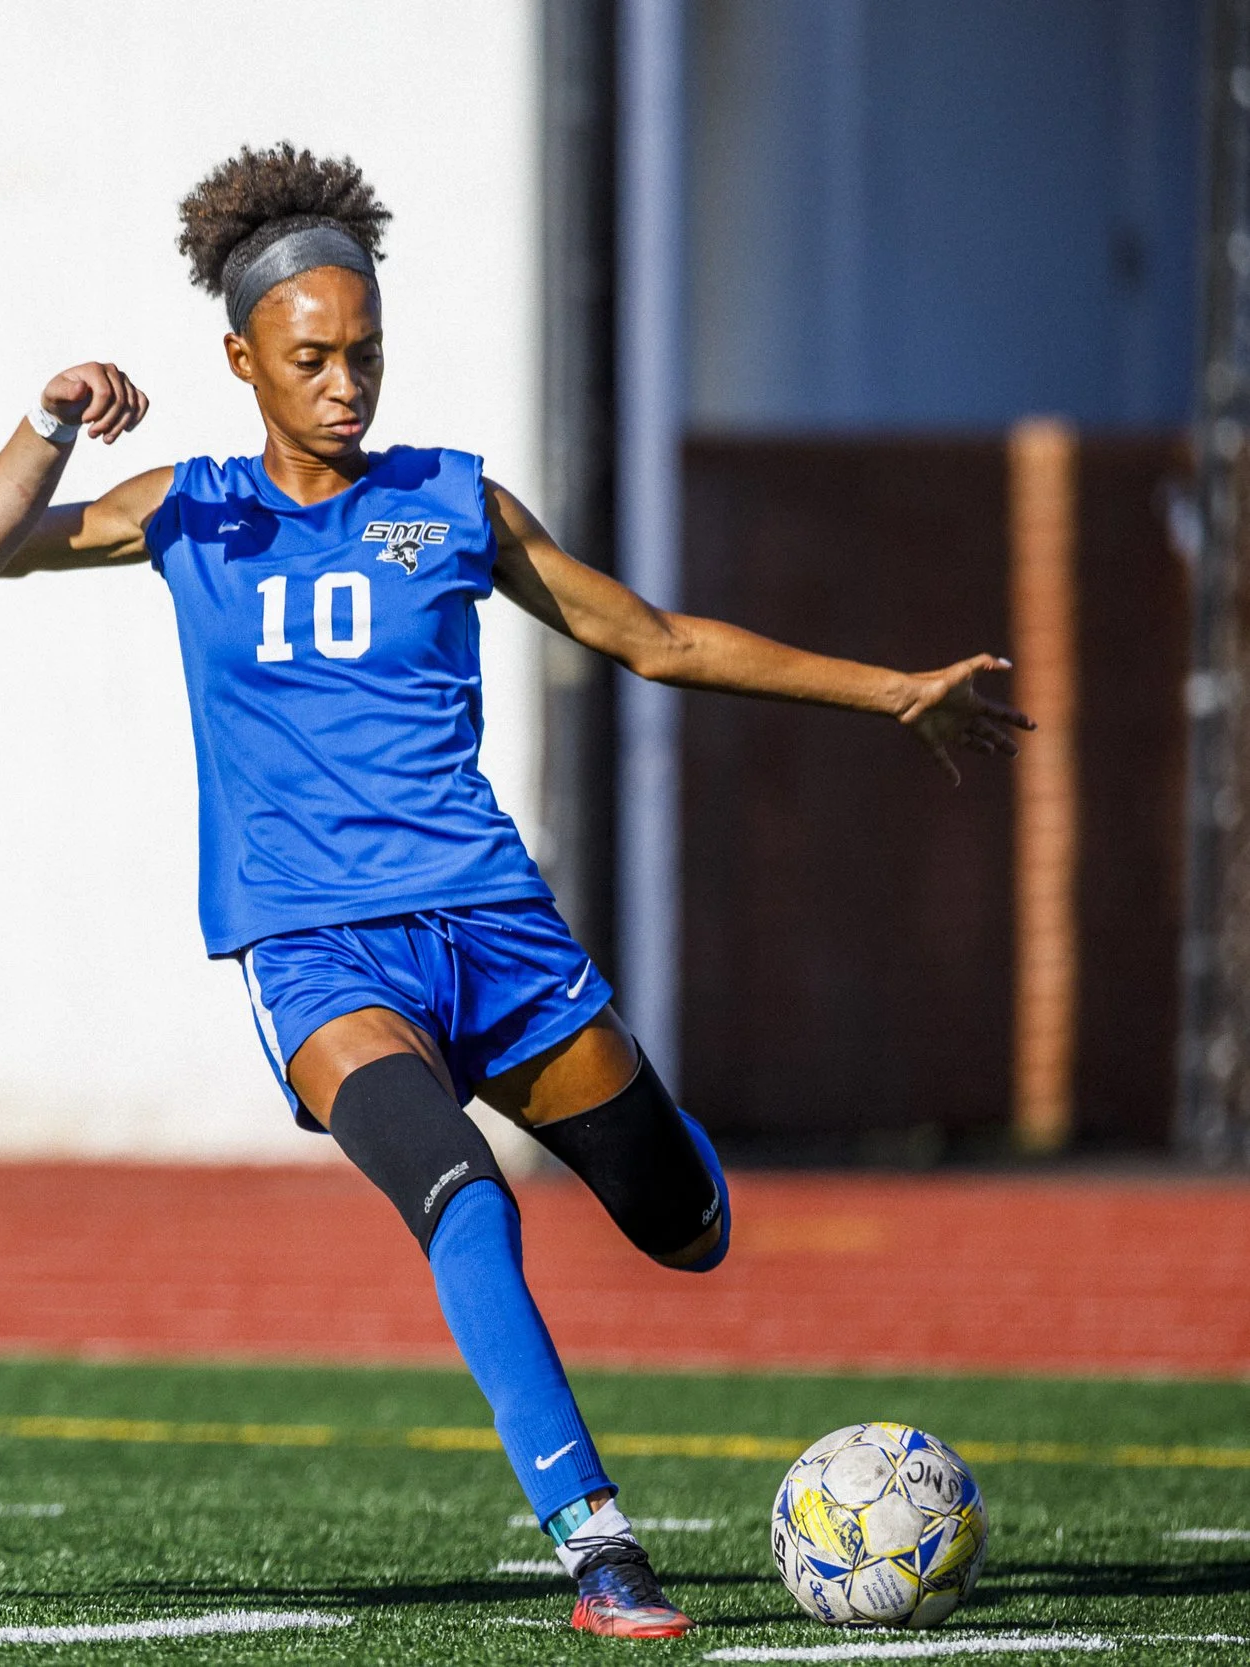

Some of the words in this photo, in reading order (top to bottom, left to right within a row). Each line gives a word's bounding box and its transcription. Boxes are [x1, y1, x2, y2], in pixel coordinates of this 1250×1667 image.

[362, 521, 450, 545] SMC
[256, 571, 371, 662] 10
[906, 1461, 960, 1503] SMC
